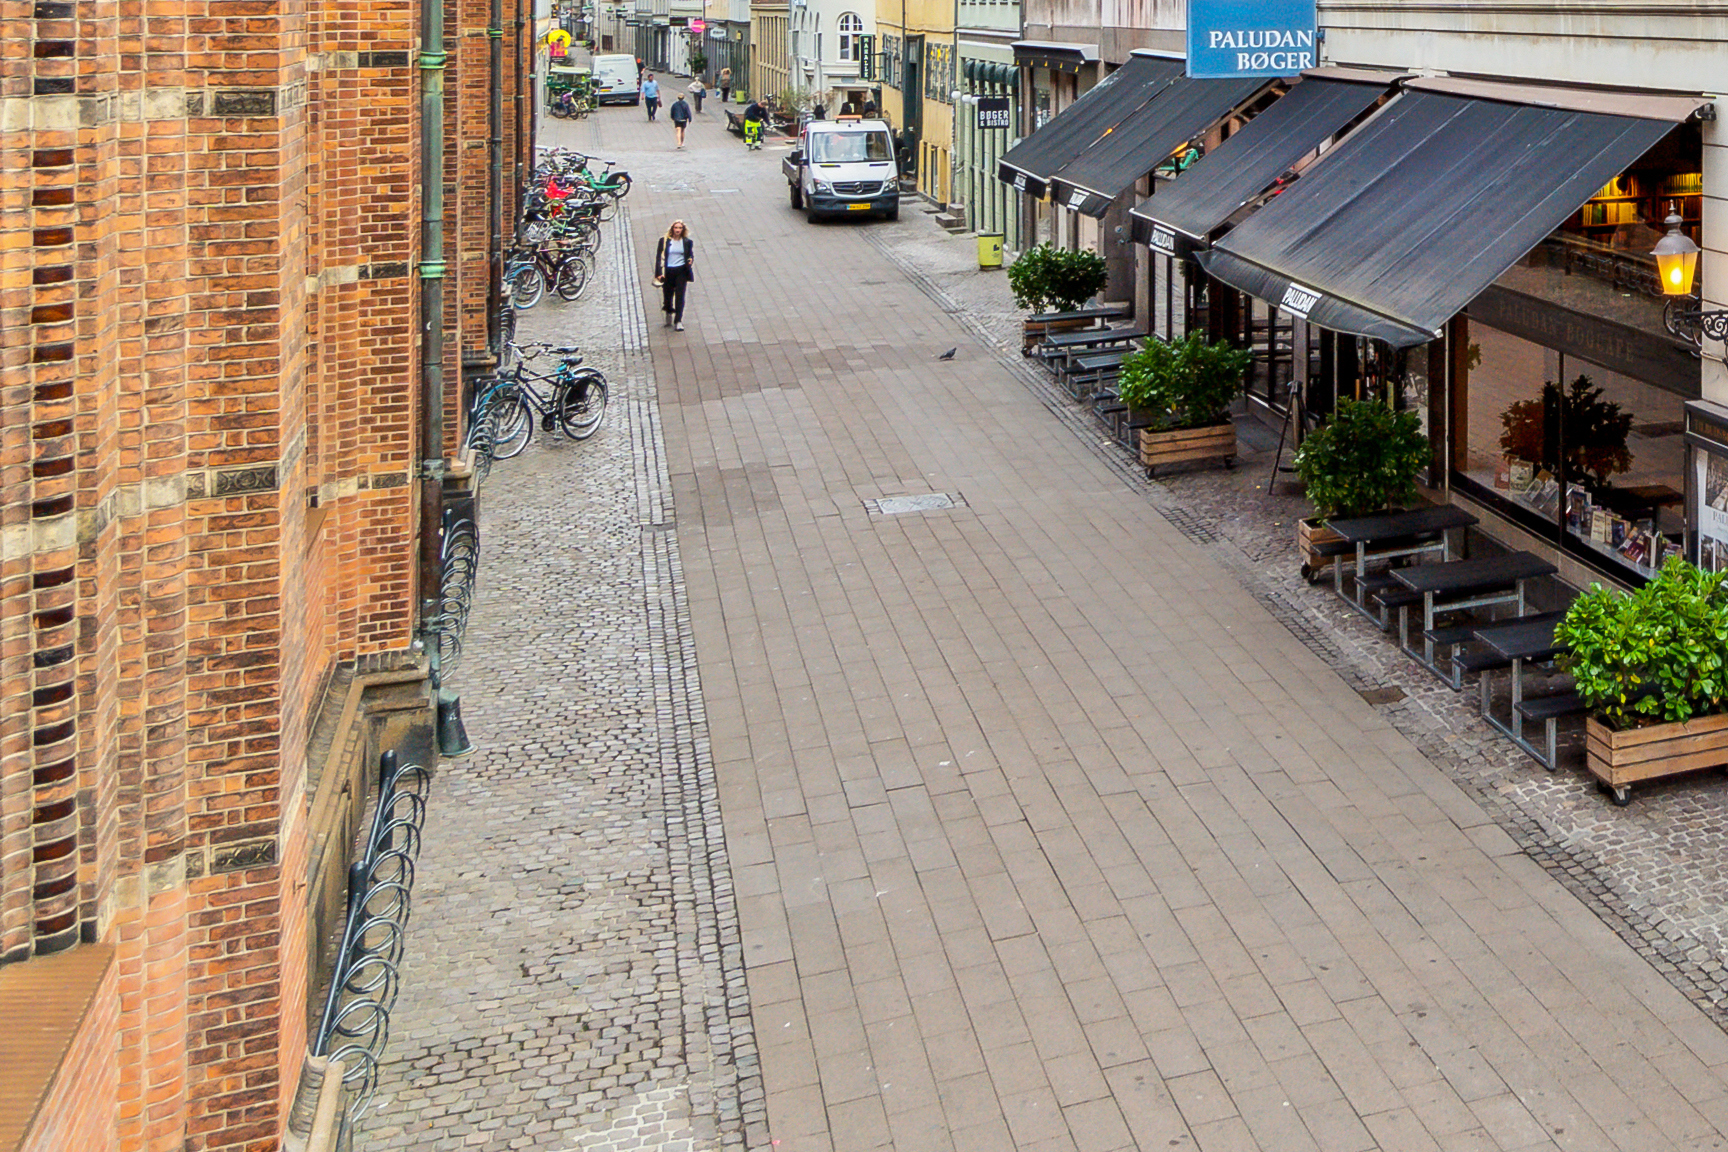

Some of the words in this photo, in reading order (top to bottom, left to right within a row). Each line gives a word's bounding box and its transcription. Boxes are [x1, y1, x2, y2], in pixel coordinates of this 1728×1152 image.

[1209, 29, 1314, 49] PALUDAN
[1237, 51, 1314, 70] BØGER
[1281, 286, 1318, 314] PALUDAN
